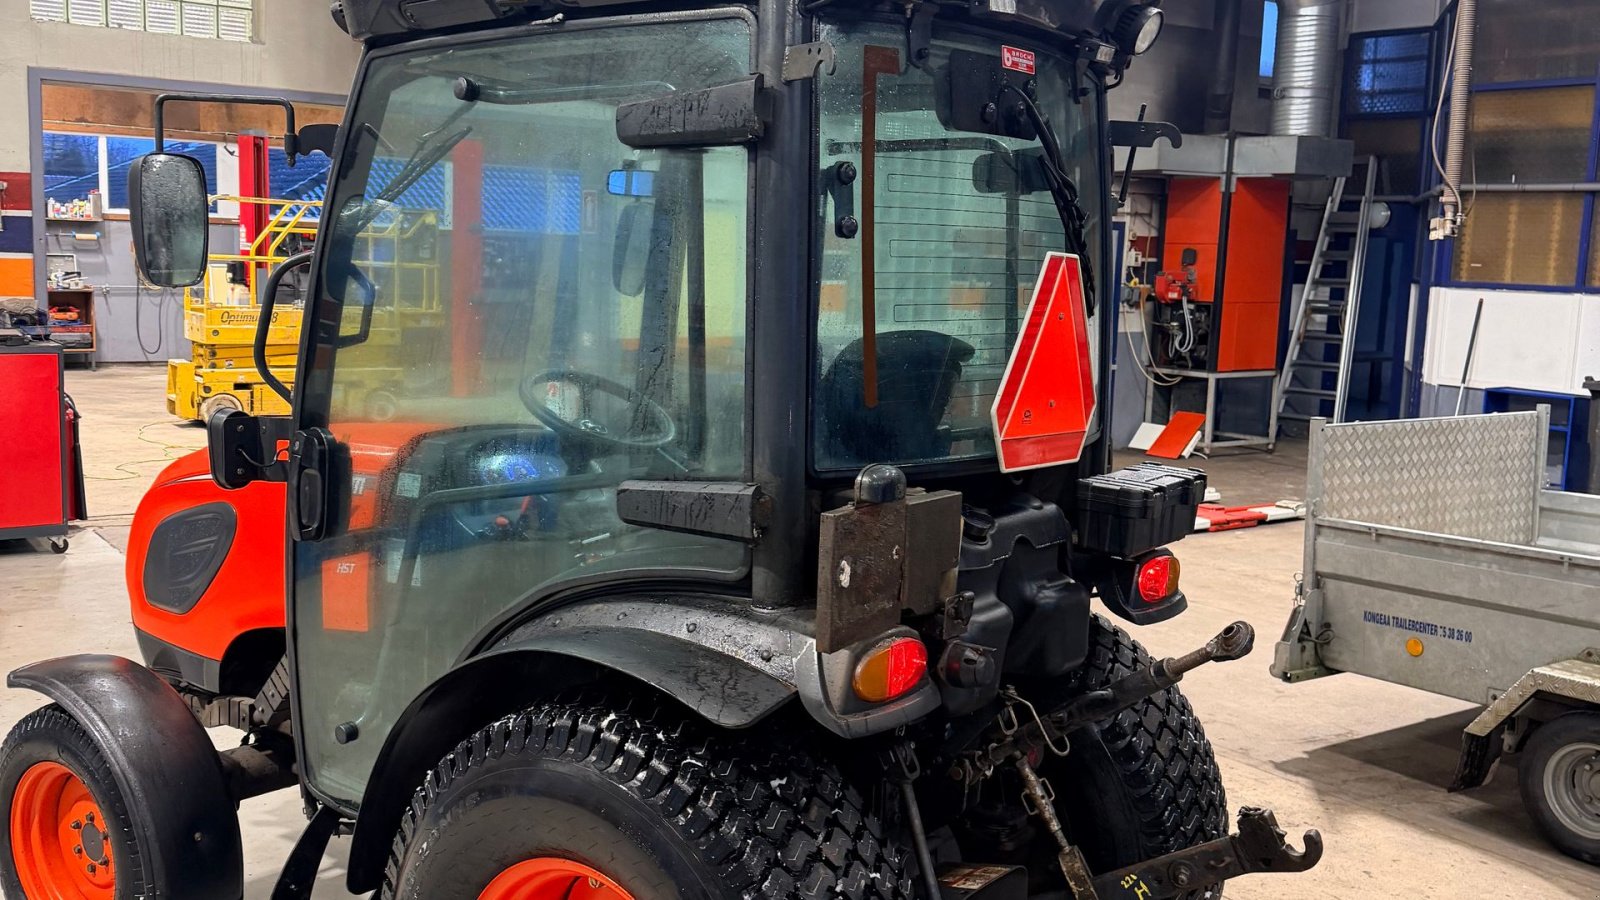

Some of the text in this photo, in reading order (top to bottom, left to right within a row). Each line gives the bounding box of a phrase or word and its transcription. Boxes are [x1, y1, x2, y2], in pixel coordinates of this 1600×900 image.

[221, 311, 259, 325] Optimu
[336, 563, 356, 574] HST
[1363, 610, 1391, 627] KONGEAA
[1391, 616, 1438, 636] TRAILERCENTER
[1447, 628, 1456, 640] 38
[1456, 630, 1464, 641] 26
[1464, 631, 1473, 643] 00
